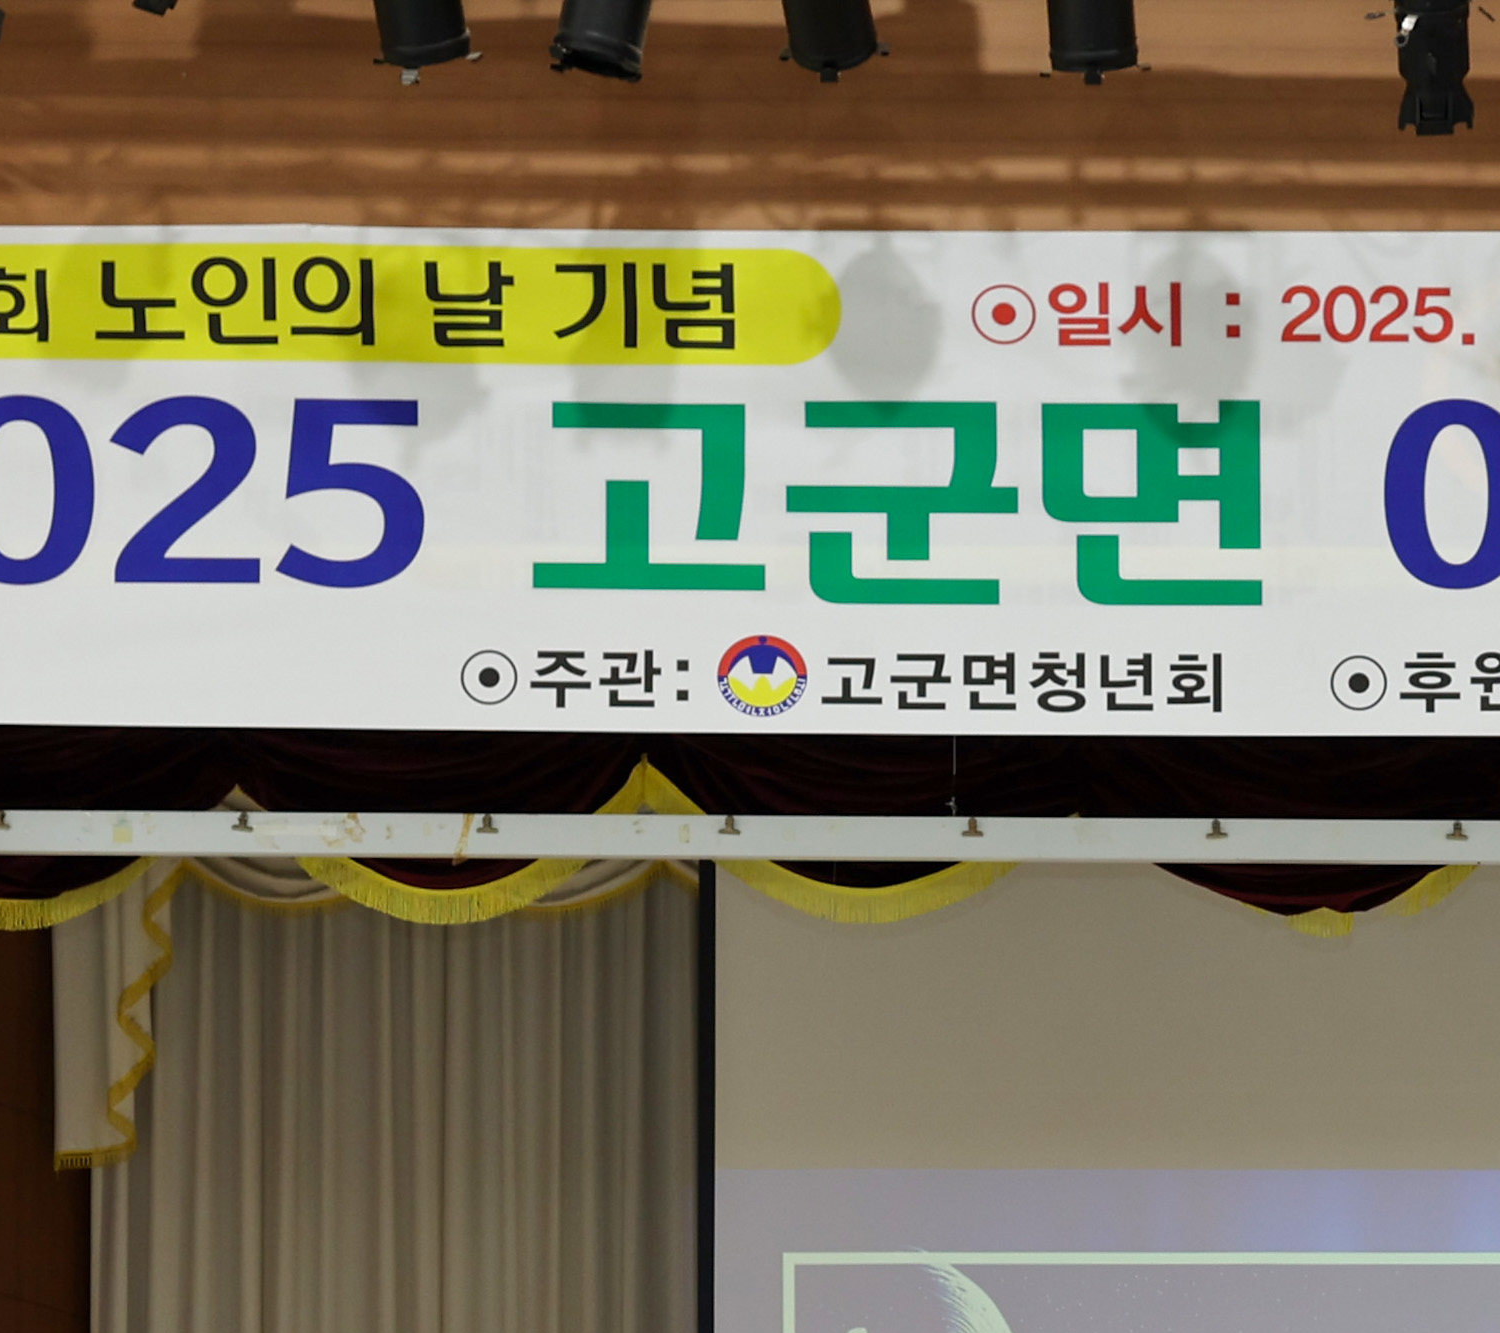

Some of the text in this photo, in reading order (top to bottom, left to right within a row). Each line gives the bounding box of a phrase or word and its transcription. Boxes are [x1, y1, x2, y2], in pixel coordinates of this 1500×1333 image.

[96, 257, 375, 346] 노인의
[425, 262, 514, 347] 날
[555, 258, 738, 348] 기념
[1049, 283, 1181, 346] 일시
[1282, 286, 1474, 345] 2025.
[533, 400, 1262, 605] 고군면
[531, 650, 1222, 712] 주관: 고군면청년회
